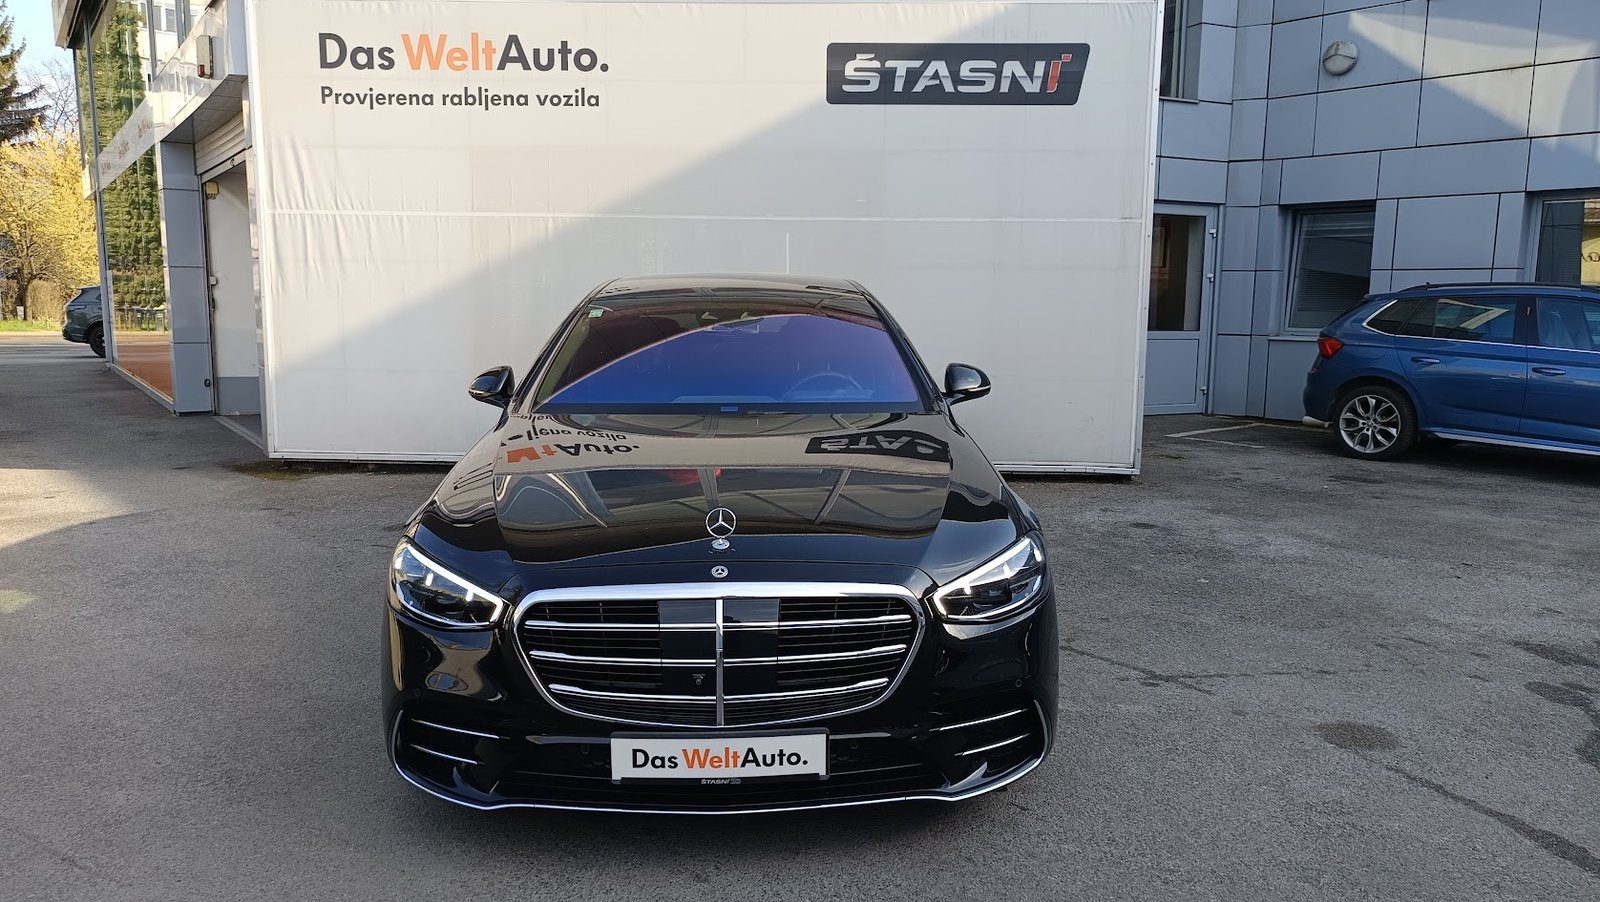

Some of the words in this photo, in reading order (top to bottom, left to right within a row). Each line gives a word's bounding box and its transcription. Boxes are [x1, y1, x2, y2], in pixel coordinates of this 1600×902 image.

[319, 32, 395, 70] Das
[401, 32, 609, 72] WeltAuto.
[320, 86, 434, 109] Provjerena
[442, 87, 529, 111] rabljena
[536, 87, 600, 107] vozila
[631, 748, 679, 769] Das
[682, 747, 808, 769] WeltAuto.
